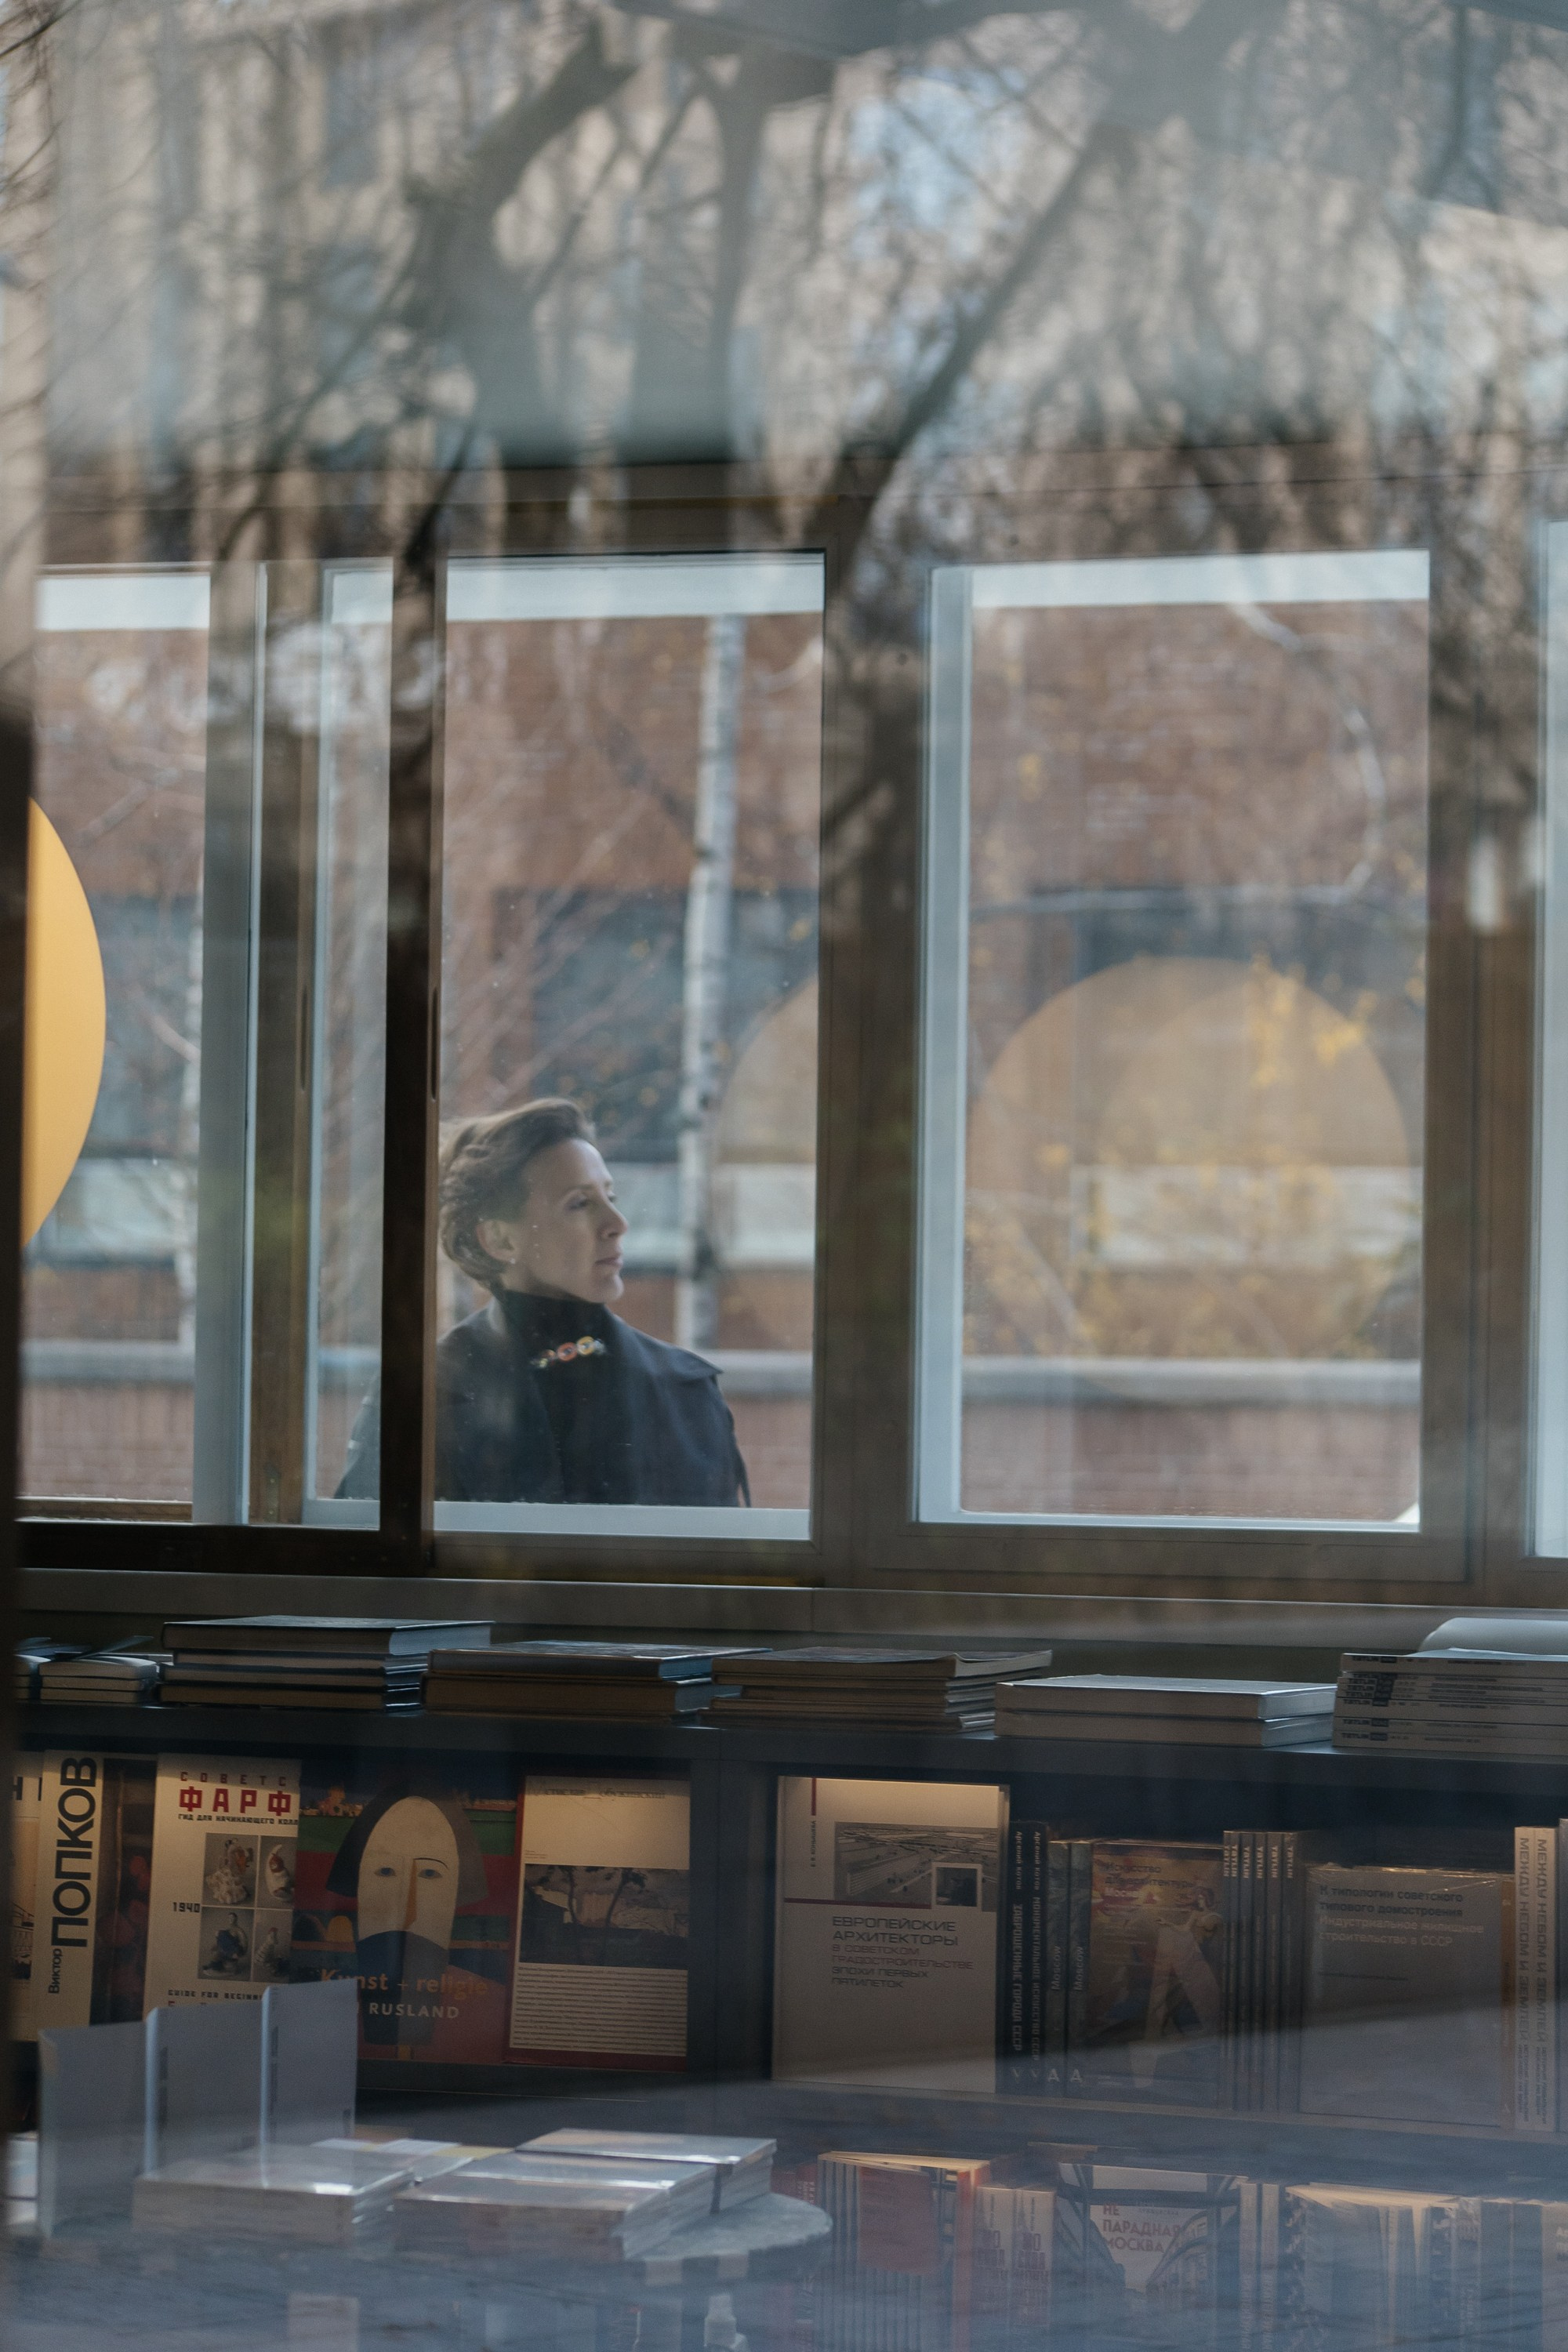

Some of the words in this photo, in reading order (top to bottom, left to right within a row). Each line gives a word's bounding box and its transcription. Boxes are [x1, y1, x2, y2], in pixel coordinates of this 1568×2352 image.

[179, 1786, 292, 1817] ФАРФ
[216, 1815, 275, 1825] НАЧИНАЮЩЕГО
[50, 1756, 96, 1948] ПОПКОВ
[1033, 1831, 1041, 1866] Арсений
[1519, 1838, 1529, 1898] МЕЖДУ
[1537, 1838, 1548, 1899] МЕЖДУ
[1319, 1886, 1327, 1895] К
[1332, 1887, 1393, 1899] типологии
[1398, 1891, 1463, 1903] советского
[172, 1901, 201, 1914] 1940
[1319, 1901, 1374, 1913] типового
[1378, 1905, 1462, 1917] домостроения
[833, 1915, 956, 1932] ЕВРОПЕЙСКИЕ
[1319, 1915, 1417, 1930] Индустриальное
[1519, 1901, 1529, 1956] НЕБОМ
[1537, 1903, 1548, 1958] НЕБОМ
[833, 1930, 958, 1946] АРХИТЕКТОРЫ
[844, 1944, 920, 1955] СОВЕТСКОМ
[1012, 1903, 1023, 1980] ЗАБРОШЕННЫЕ
[1031, 1896, 1040, 1981] МОНУМЕНТАЛЬНОЕ
[1319, 1932, 1407, 1945] строительство
[1421, 1936, 1453, 1947] СССР
[48, 1948, 63, 1994] Виктор
[831, 1966, 874, 1976] ЭПОХИ
[878, 1968, 929, 1978] ПЕРВЫХ
[832, 1955, 975, 1969] ГРАДОСТРОИТЕЛЬСТВЕ
[1051, 1946, 1062, 1991] Moscow
[1073, 1946, 1084, 1992] Moscow
[1519, 1960, 1529, 1970] И
[1537, 1962, 1548, 1973] И
[321, 1969, 389, 1991] Knst
[416, 1973, 488, 2000] religie
[831, 1977, 904, 1988] ПЯТИЛЕТОК
[368, 2002, 460, 2019] RUSLAND
[1012, 1981, 1022, 2026] ГОРОДА
[1031, 1982, 1040, 2035] ИСКУССТВО
[1519, 1976, 1530, 2040] ЗЕМЛЕЙ
[1537, 1976, 1549, 2042] ЗЕМЛЕЙ
[1012, 2027, 1022, 2051] СССР
[1103, 2204, 1120, 2216] НЕ
[1102, 2219, 1181, 2238] ПАРАДНАЯ
